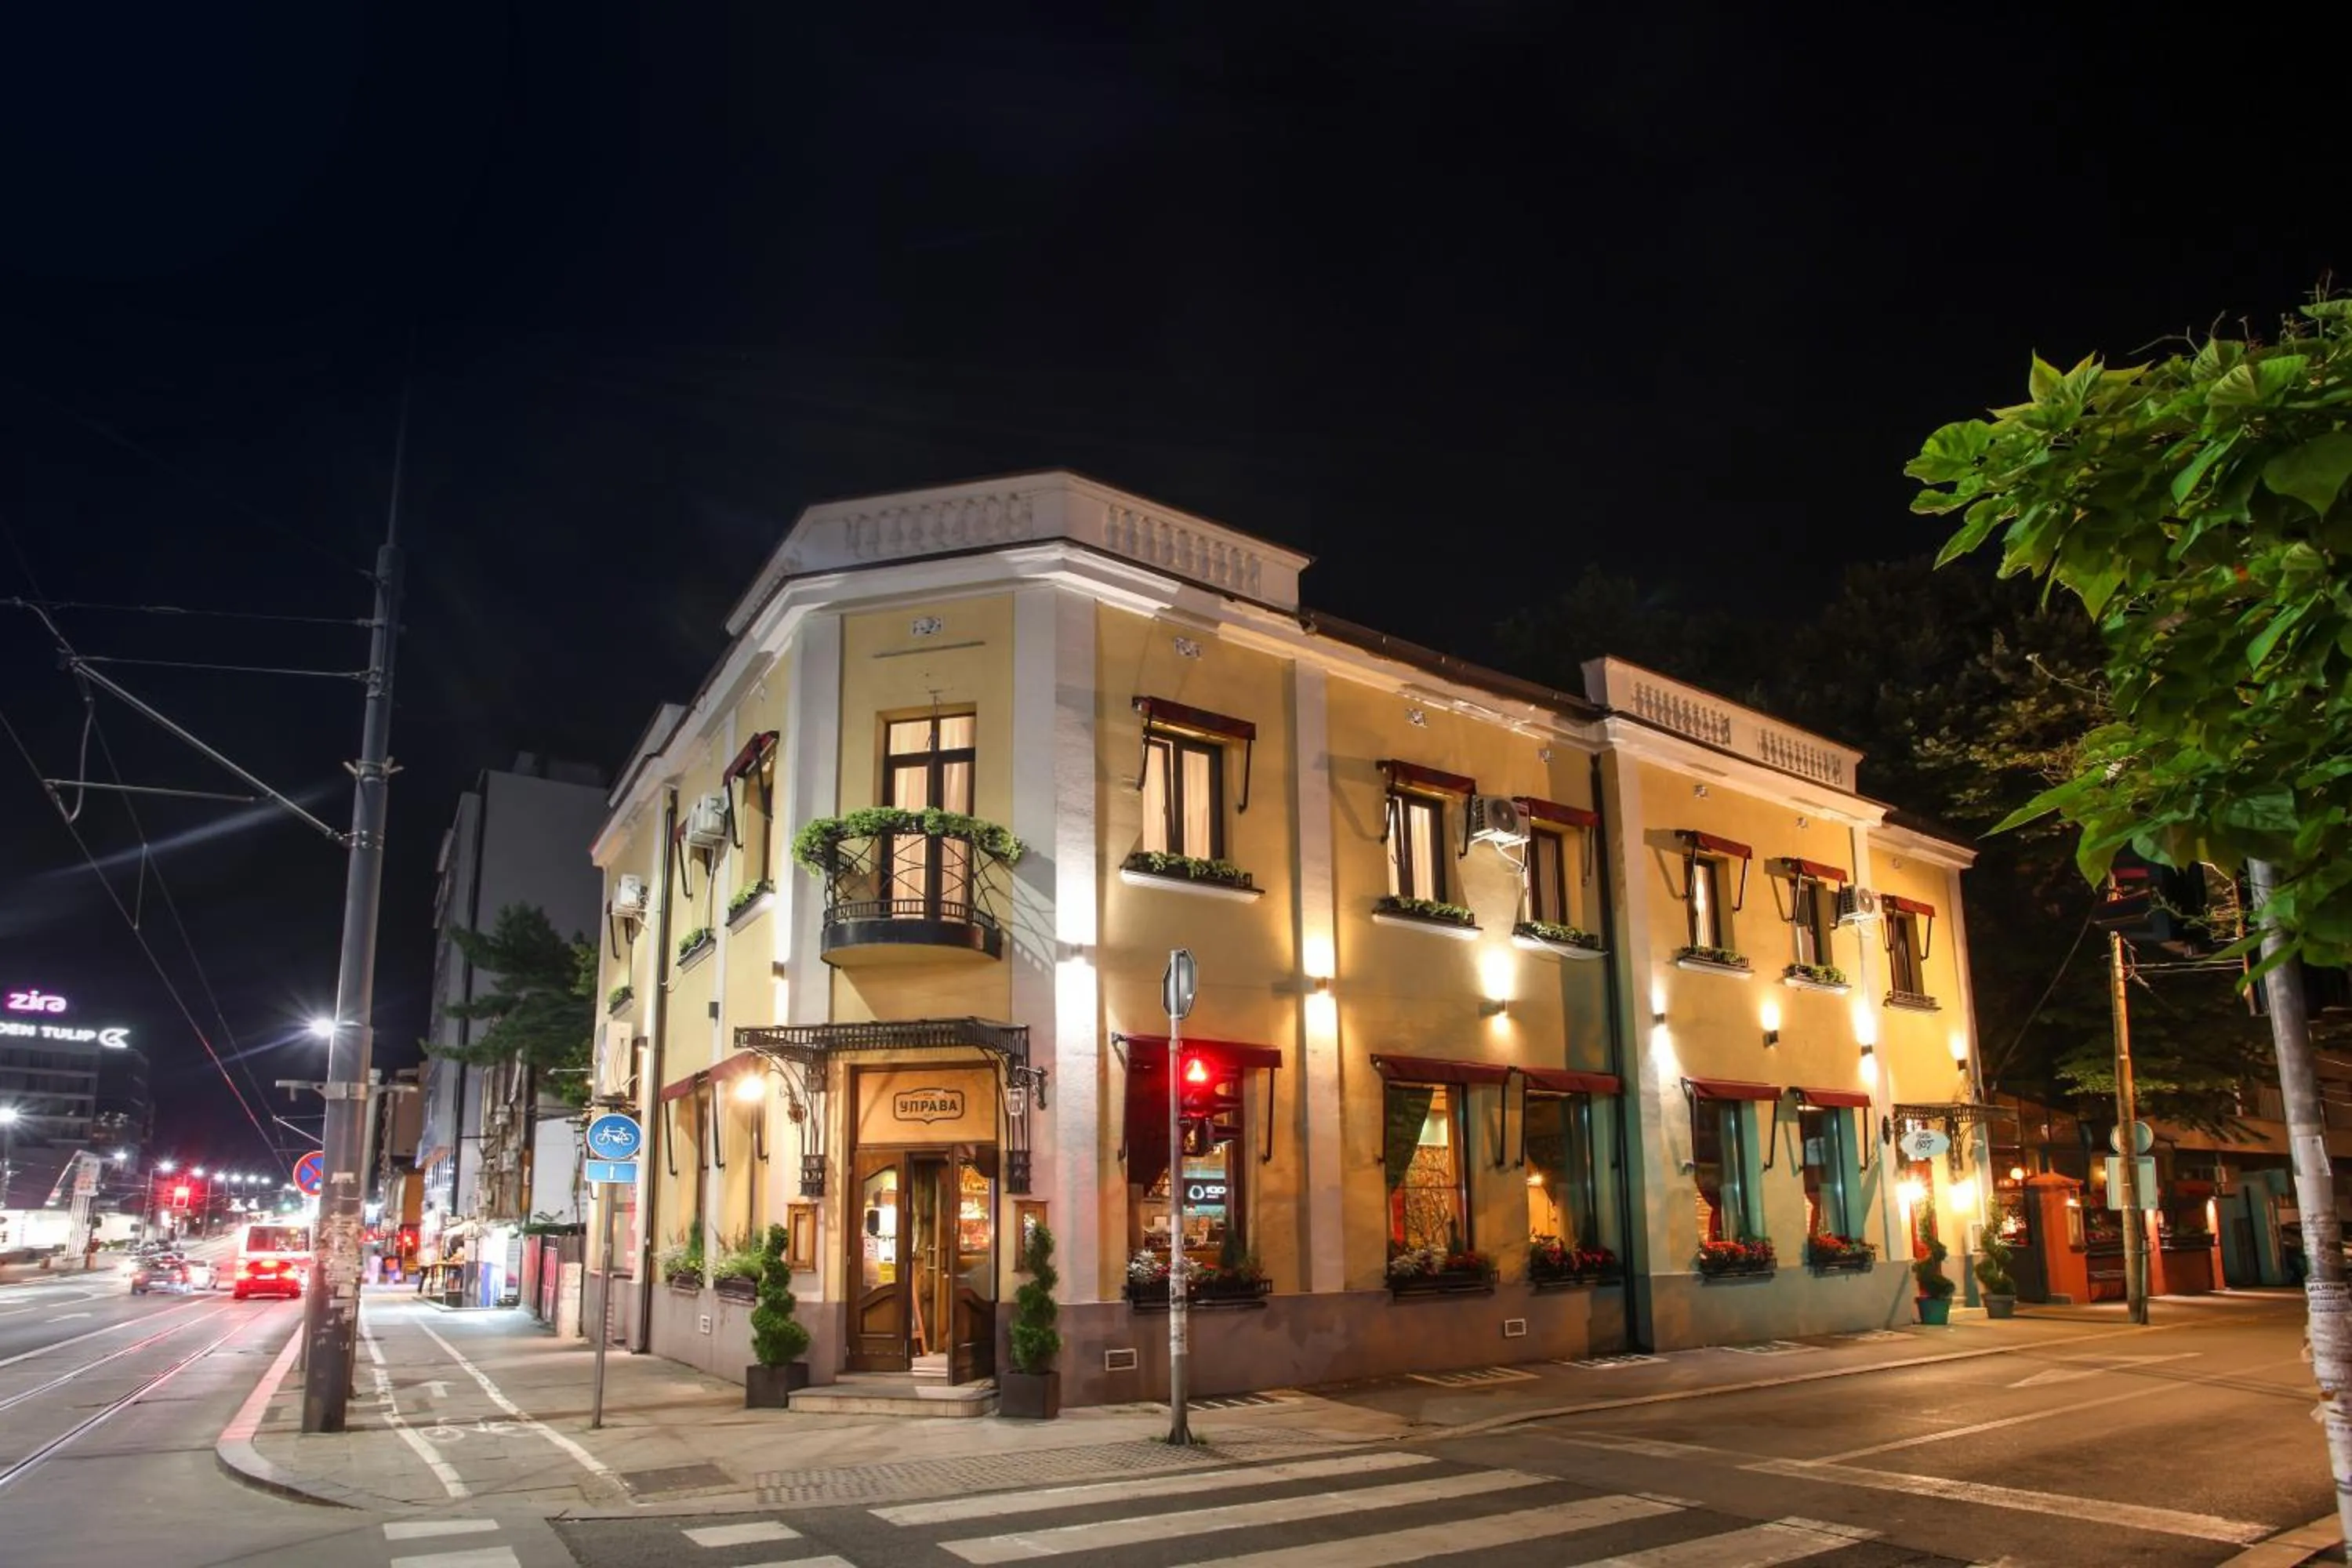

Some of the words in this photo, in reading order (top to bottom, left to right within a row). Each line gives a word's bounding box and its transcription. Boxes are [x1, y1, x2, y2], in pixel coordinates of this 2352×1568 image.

[8, 990, 67, 1012] zira
[41, 1025, 97, 1041] TULIP
[899, 1099, 957, 1112] УПРАВА
